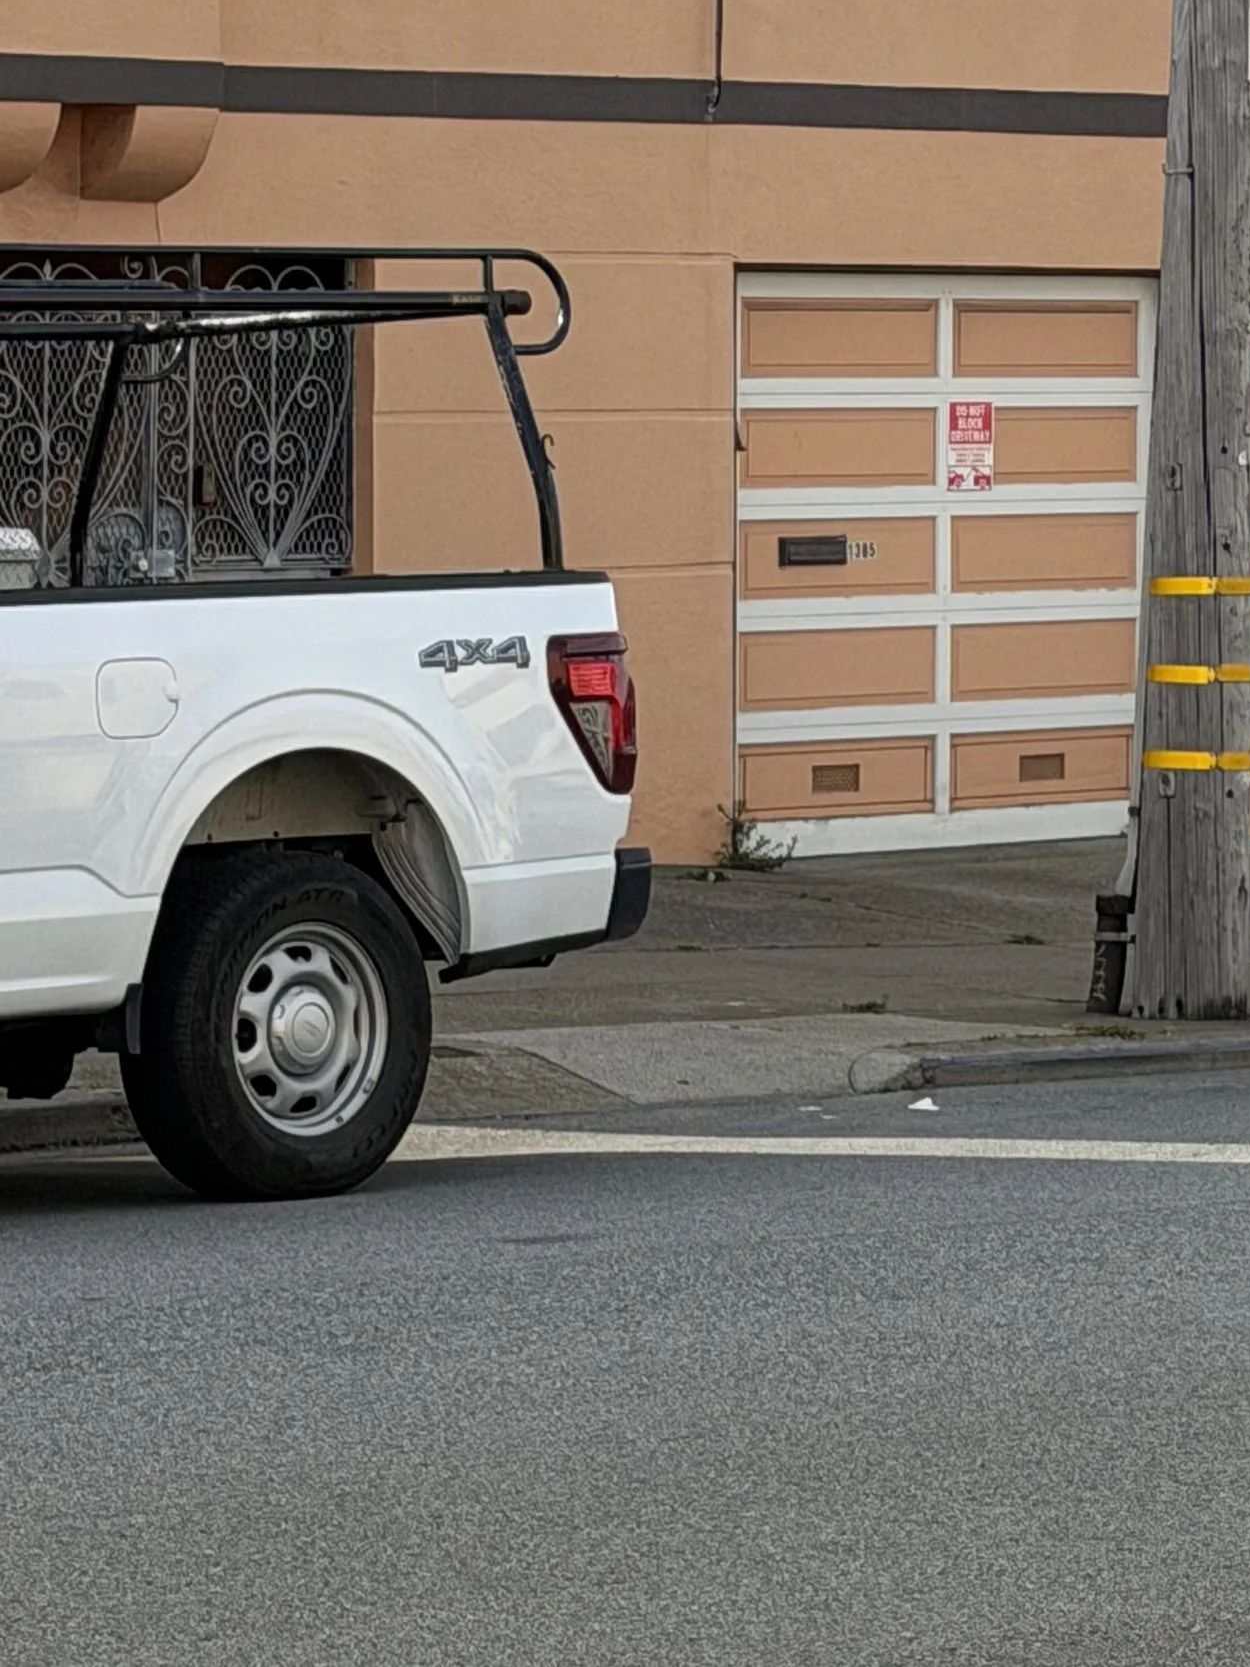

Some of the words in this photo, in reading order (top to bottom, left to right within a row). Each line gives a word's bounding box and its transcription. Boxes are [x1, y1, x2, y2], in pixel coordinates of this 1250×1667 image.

[956, 405, 968, 416] DO
[969, 405, 986, 416] NOT
[958, 417, 983, 429] BLOCK
[950, 430, 990, 442] DRIVEWAY
